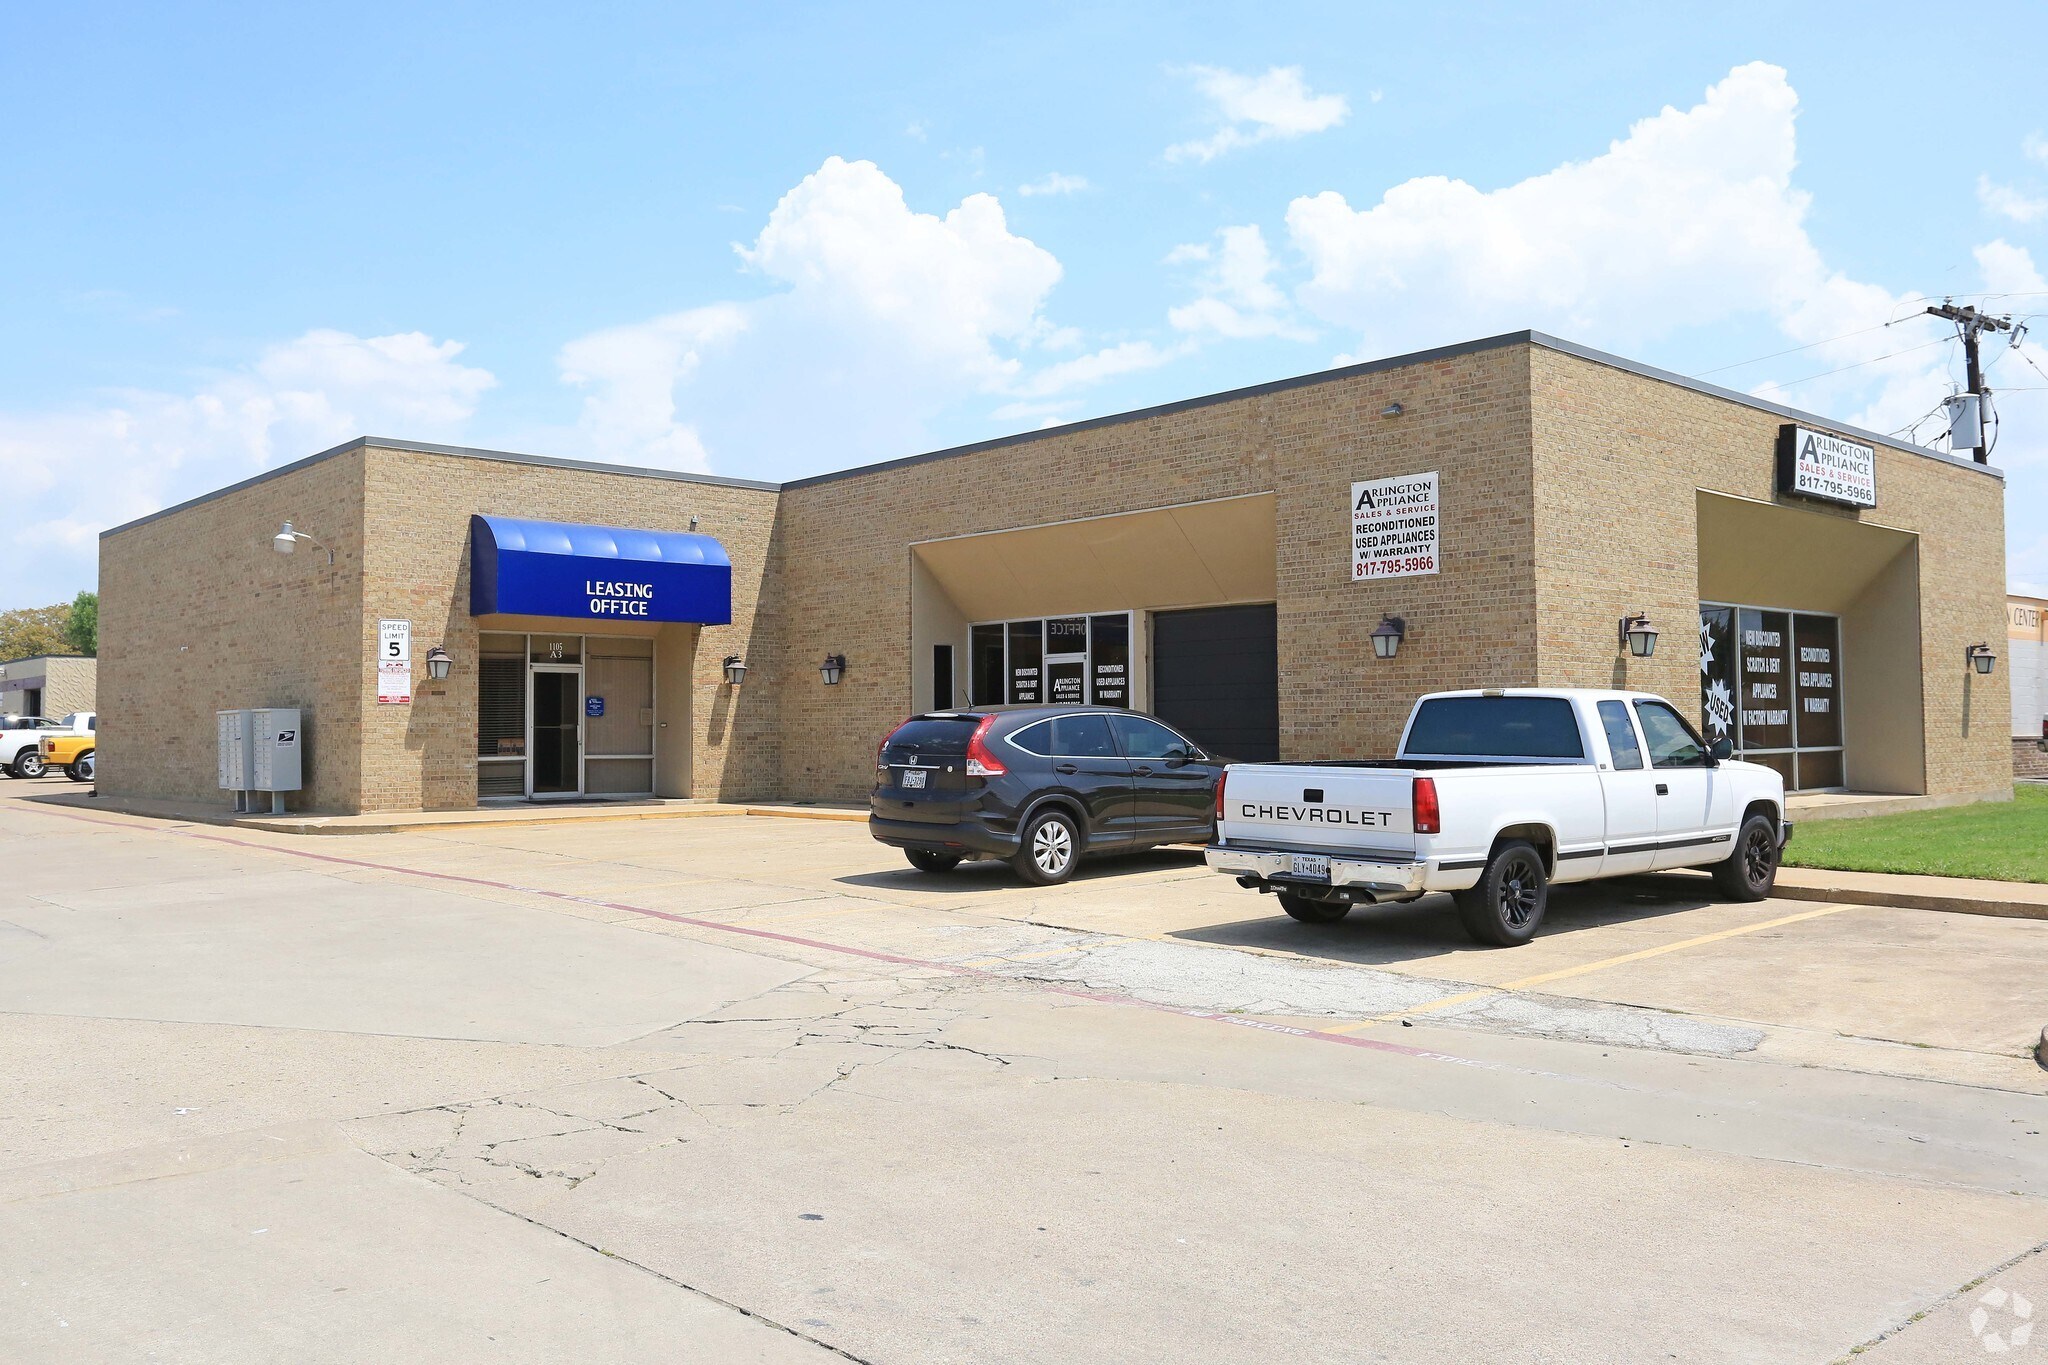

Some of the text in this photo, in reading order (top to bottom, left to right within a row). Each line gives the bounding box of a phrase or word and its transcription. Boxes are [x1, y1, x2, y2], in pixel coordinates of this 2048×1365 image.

[1799, 435, 1870, 464] ARLINGTON
[1799, 462, 1871, 487] SALES & SERVICE
[1355, 481, 1431, 510] ARLINGTON
[1799, 475, 1872, 500] 817-795-5966
[1354, 510, 1382, 519] SALES
[1396, 504, 1436, 515] SERVICE
[1356, 516, 1435, 534] RECONDITIONED
[1355, 529, 1435, 549] USED APPLIANCES
[1359, 544, 1431, 559] W/ WARRANTY
[1356, 556, 1434, 576] 817-795-5966
[586, 581, 653, 598] LEASING
[590, 598, 648, 615] OFFICE
[2014, 607, 2040, 628] CENTER
[549, 642, 563, 651] 1105
[1745, 630, 1780, 647] NEW DISCOUNTED
[389, 642, 400, 656] 5
[1801, 647, 1830, 663] RECONDITIONED
[1747, 657, 1780, 673] SCRATCH & DENT
[1053, 678, 1081, 692] ARLINGTON
[1105, 678, 1125, 686] APPLIANCES
[1800, 672, 1832, 688] USED APPLIANCES
[1752, 683, 1777, 699] APPLIANCES
[1710, 694, 1729, 723] USED
[1809, 698, 1829, 712] WARRANTY
[1748, 710, 1766, 725] FACTORY
[1767, 710, 1788, 725] WARRANTY
[1242, 804, 1392, 826] CHEVROLET
